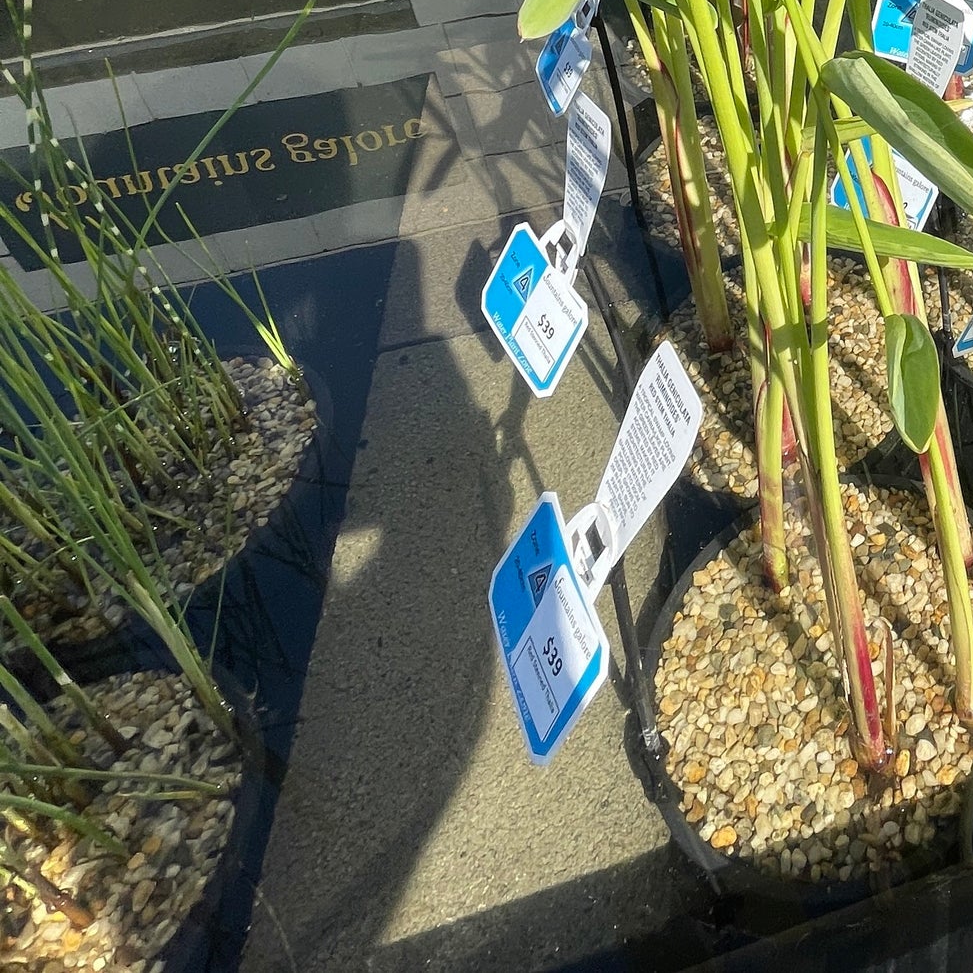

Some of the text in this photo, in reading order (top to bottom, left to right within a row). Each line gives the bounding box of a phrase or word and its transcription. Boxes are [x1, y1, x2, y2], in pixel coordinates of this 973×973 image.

[520, 276, 530, 291] 4
[492, 311, 507, 335] Water
[518, 352, 532, 375] Zone
[537, 314, 555, 340] $39
[648, 382, 675, 437] RED STEM THALIA
[655, 352, 691, 426] THALIA GENICULATA
[534, 573, 546, 594] 4
[554, 577, 592, 661] fountains galore
[542, 635, 564, 677] $39
